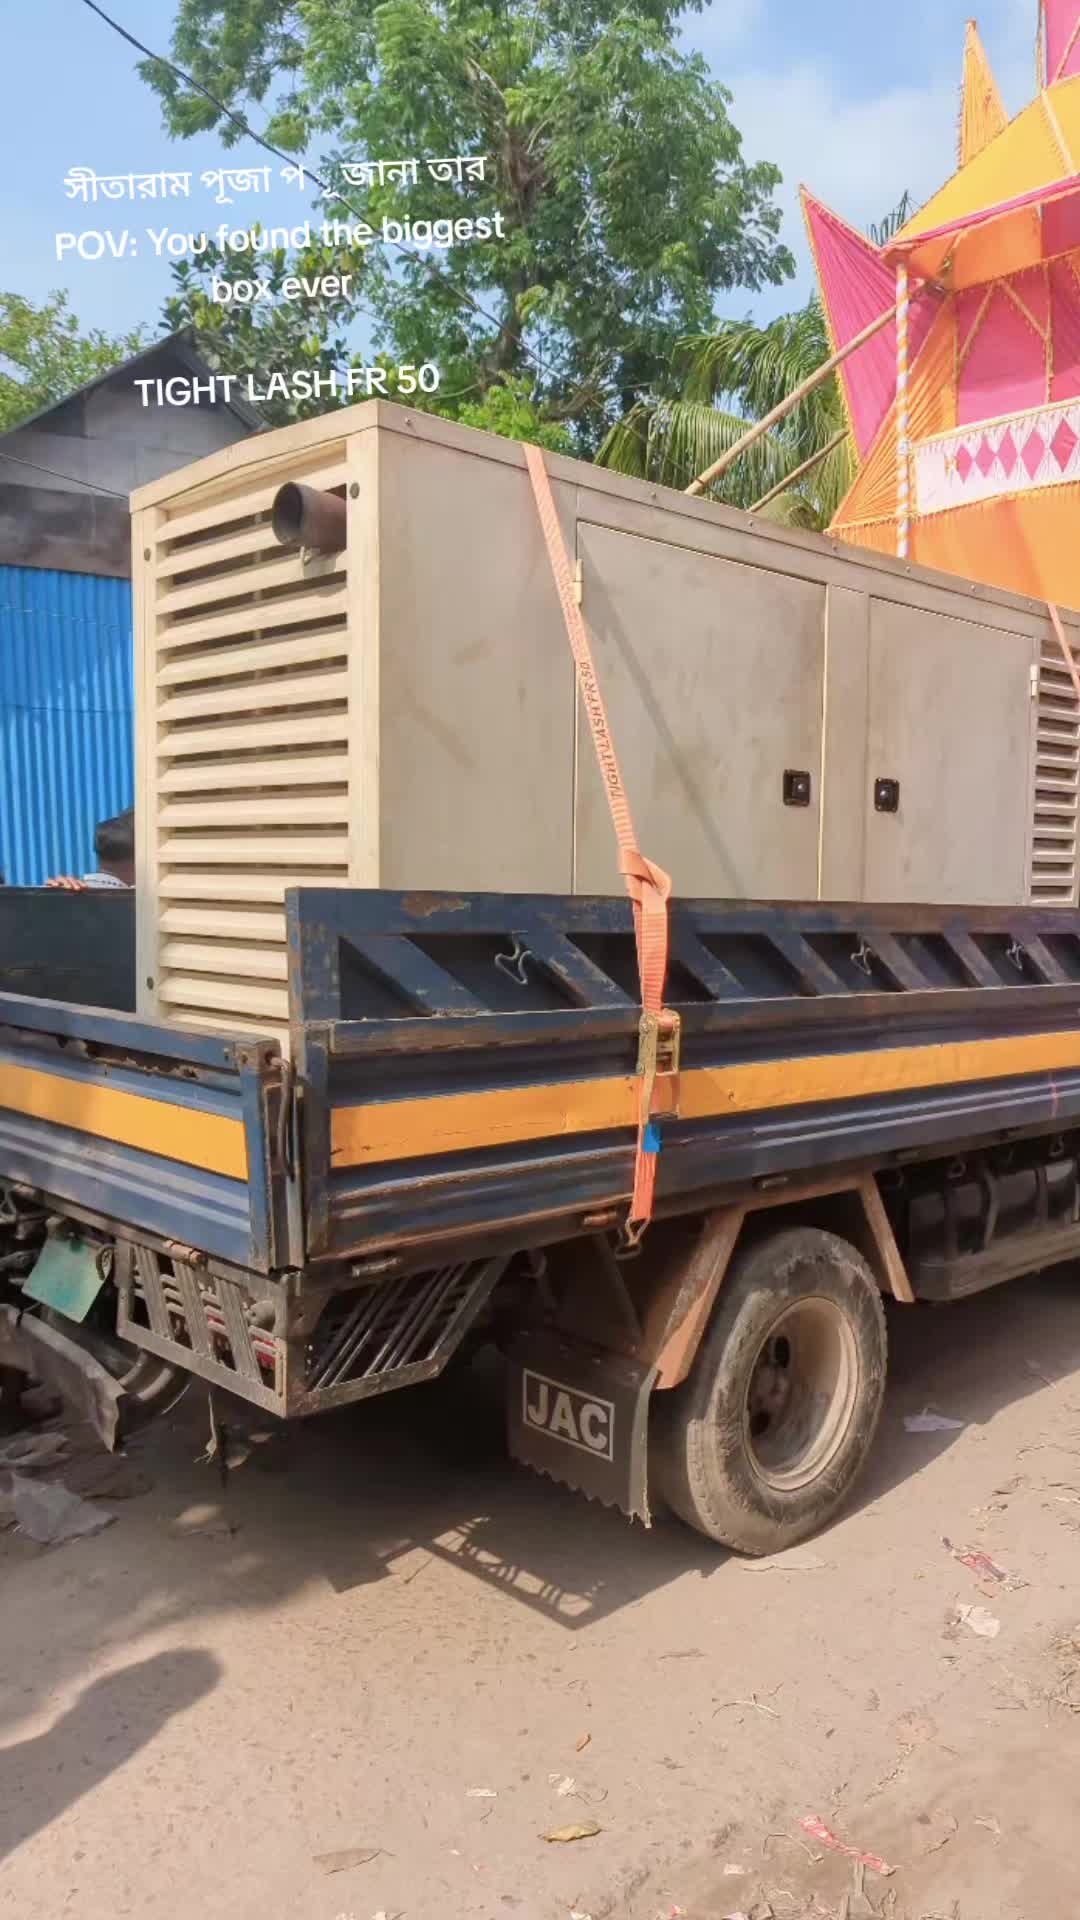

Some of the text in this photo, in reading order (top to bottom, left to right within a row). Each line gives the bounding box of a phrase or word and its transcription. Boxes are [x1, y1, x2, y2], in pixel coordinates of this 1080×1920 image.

[580, 661, 593, 679] 50
[592, 706, 611, 750] LASH
[602, 752, 624, 801] TIGHT
[527, 1383, 609, 1451] JAC
